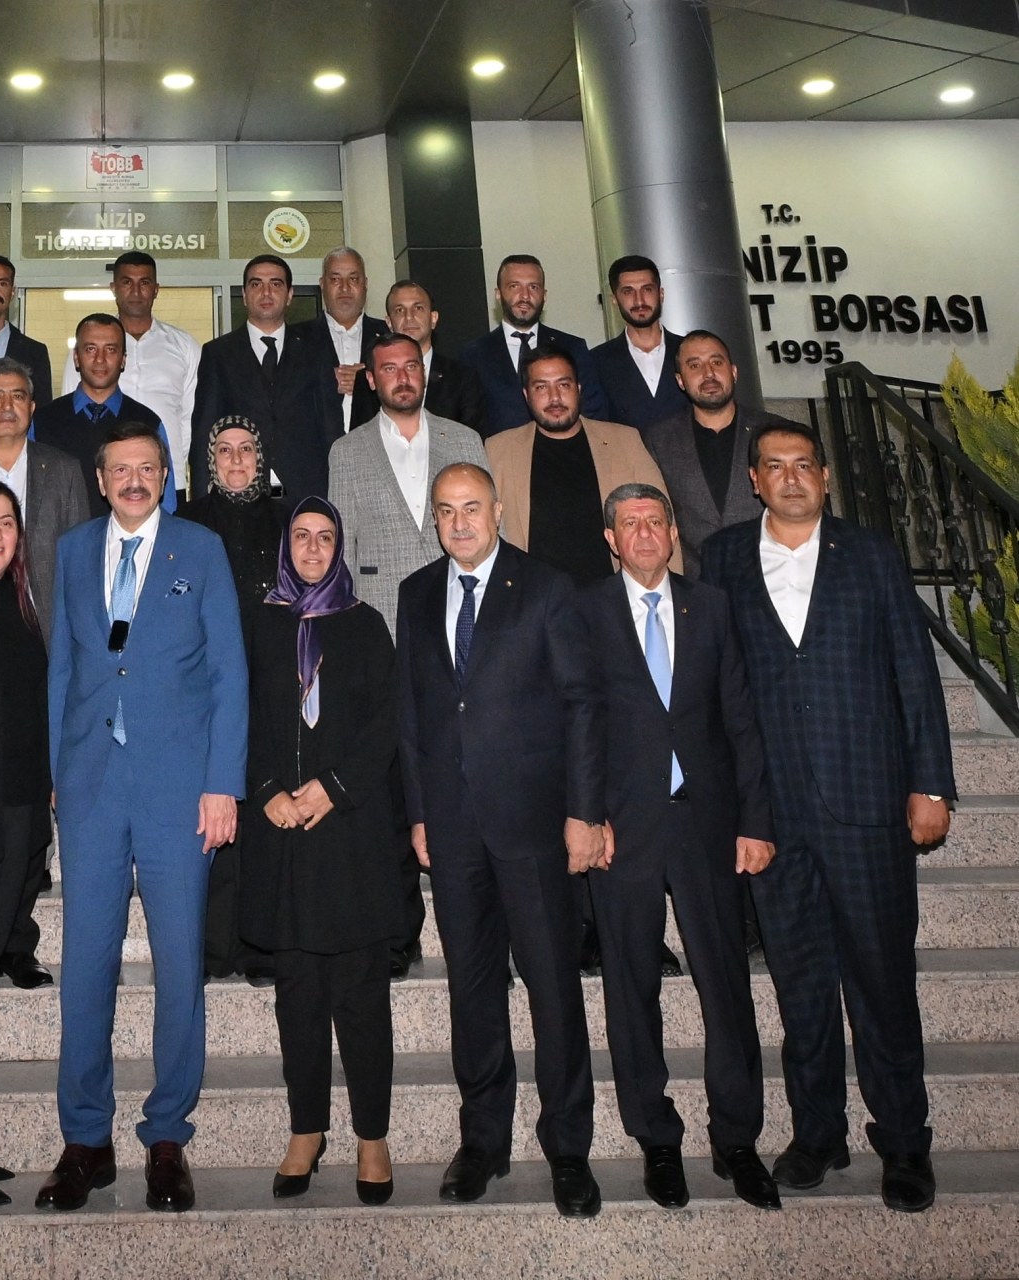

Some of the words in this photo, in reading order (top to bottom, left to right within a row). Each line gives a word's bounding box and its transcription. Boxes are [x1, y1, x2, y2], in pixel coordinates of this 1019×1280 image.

[99, 157, 133, 172] TOBB
[95, 209, 146, 228] NİZİP
[761, 203, 801, 224] T.C.
[35, 231, 116, 251] TİCARET
[123, 234, 205, 251] BORSASI
[742, 234, 848, 283] NİZİP
[811, 294, 988, 334] BORSASI
[766, 340, 844, 365] 1995
